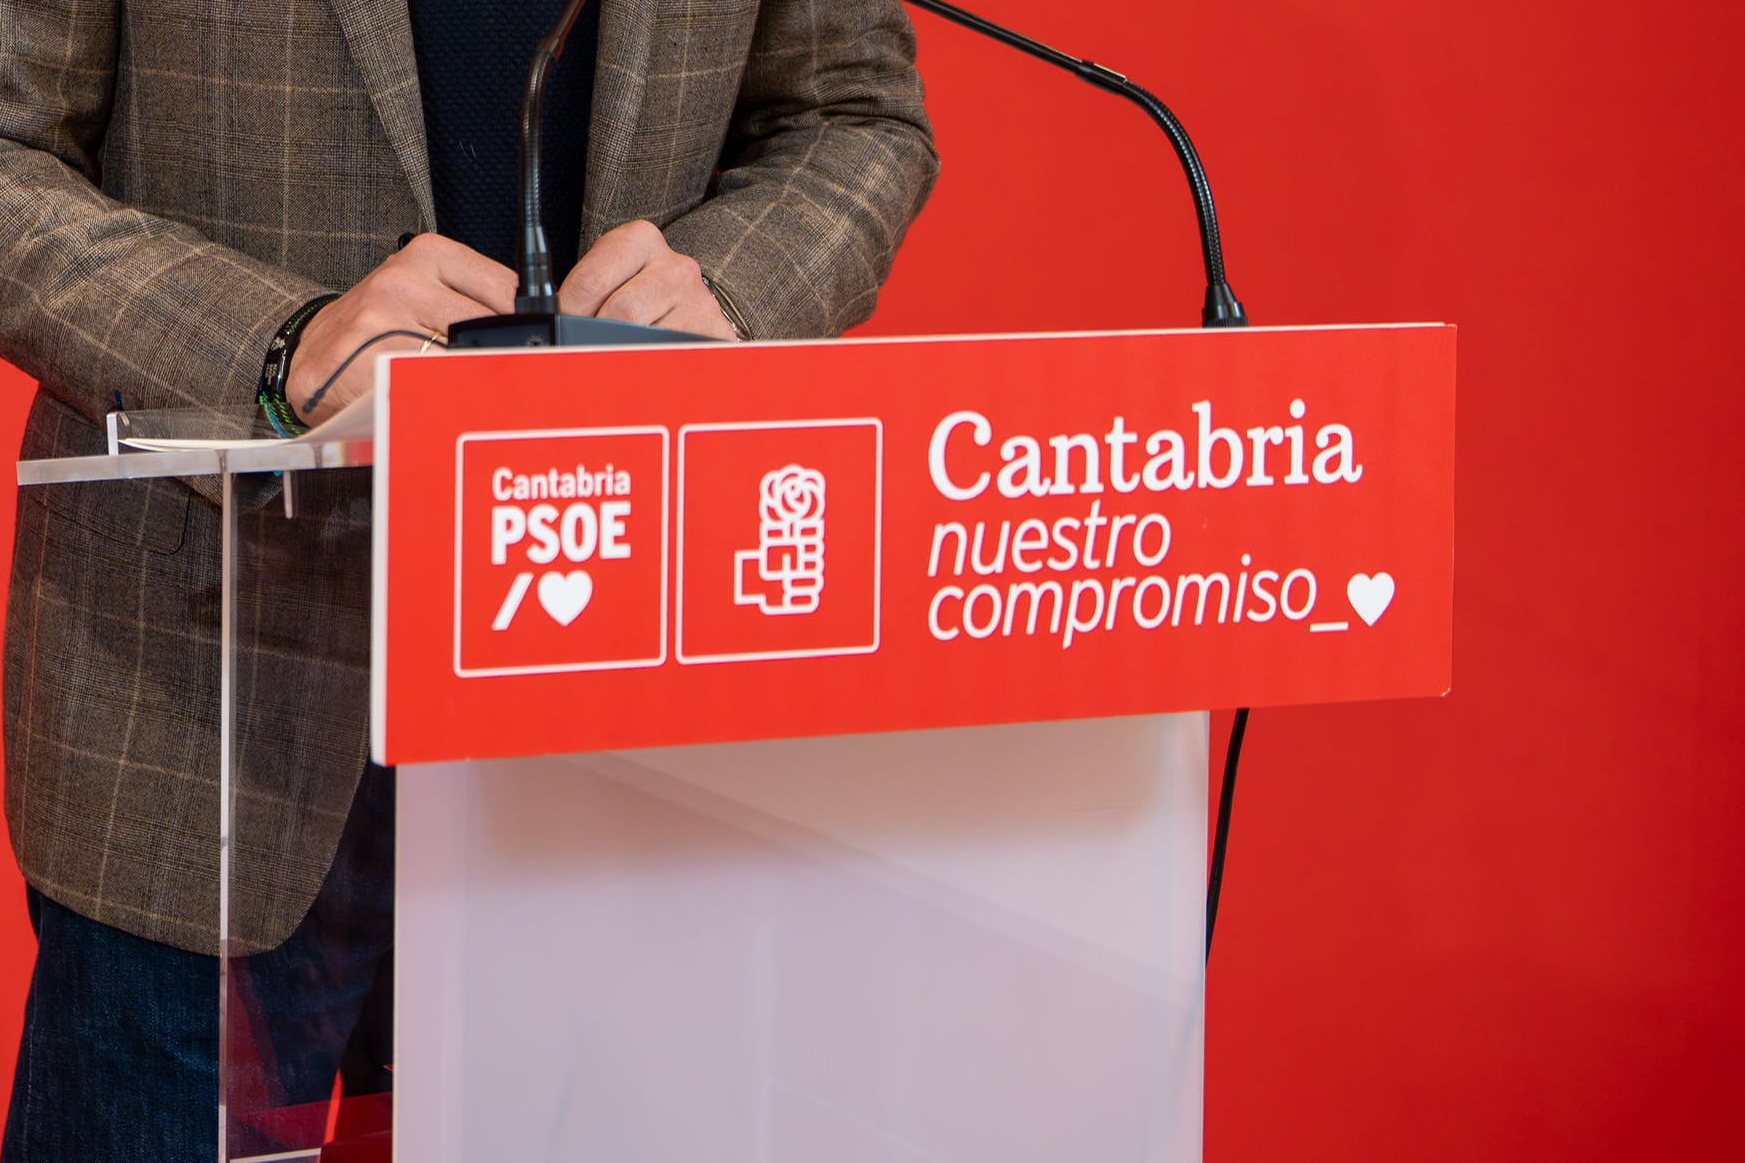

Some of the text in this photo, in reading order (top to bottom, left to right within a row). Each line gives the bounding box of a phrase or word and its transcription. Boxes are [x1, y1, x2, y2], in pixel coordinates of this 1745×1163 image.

[491, 463, 632, 502] Cantabria
[926, 398, 1364, 502] Cantabria
[490, 500, 633, 566] PSOE
[926, 498, 1172, 578] nuestro
